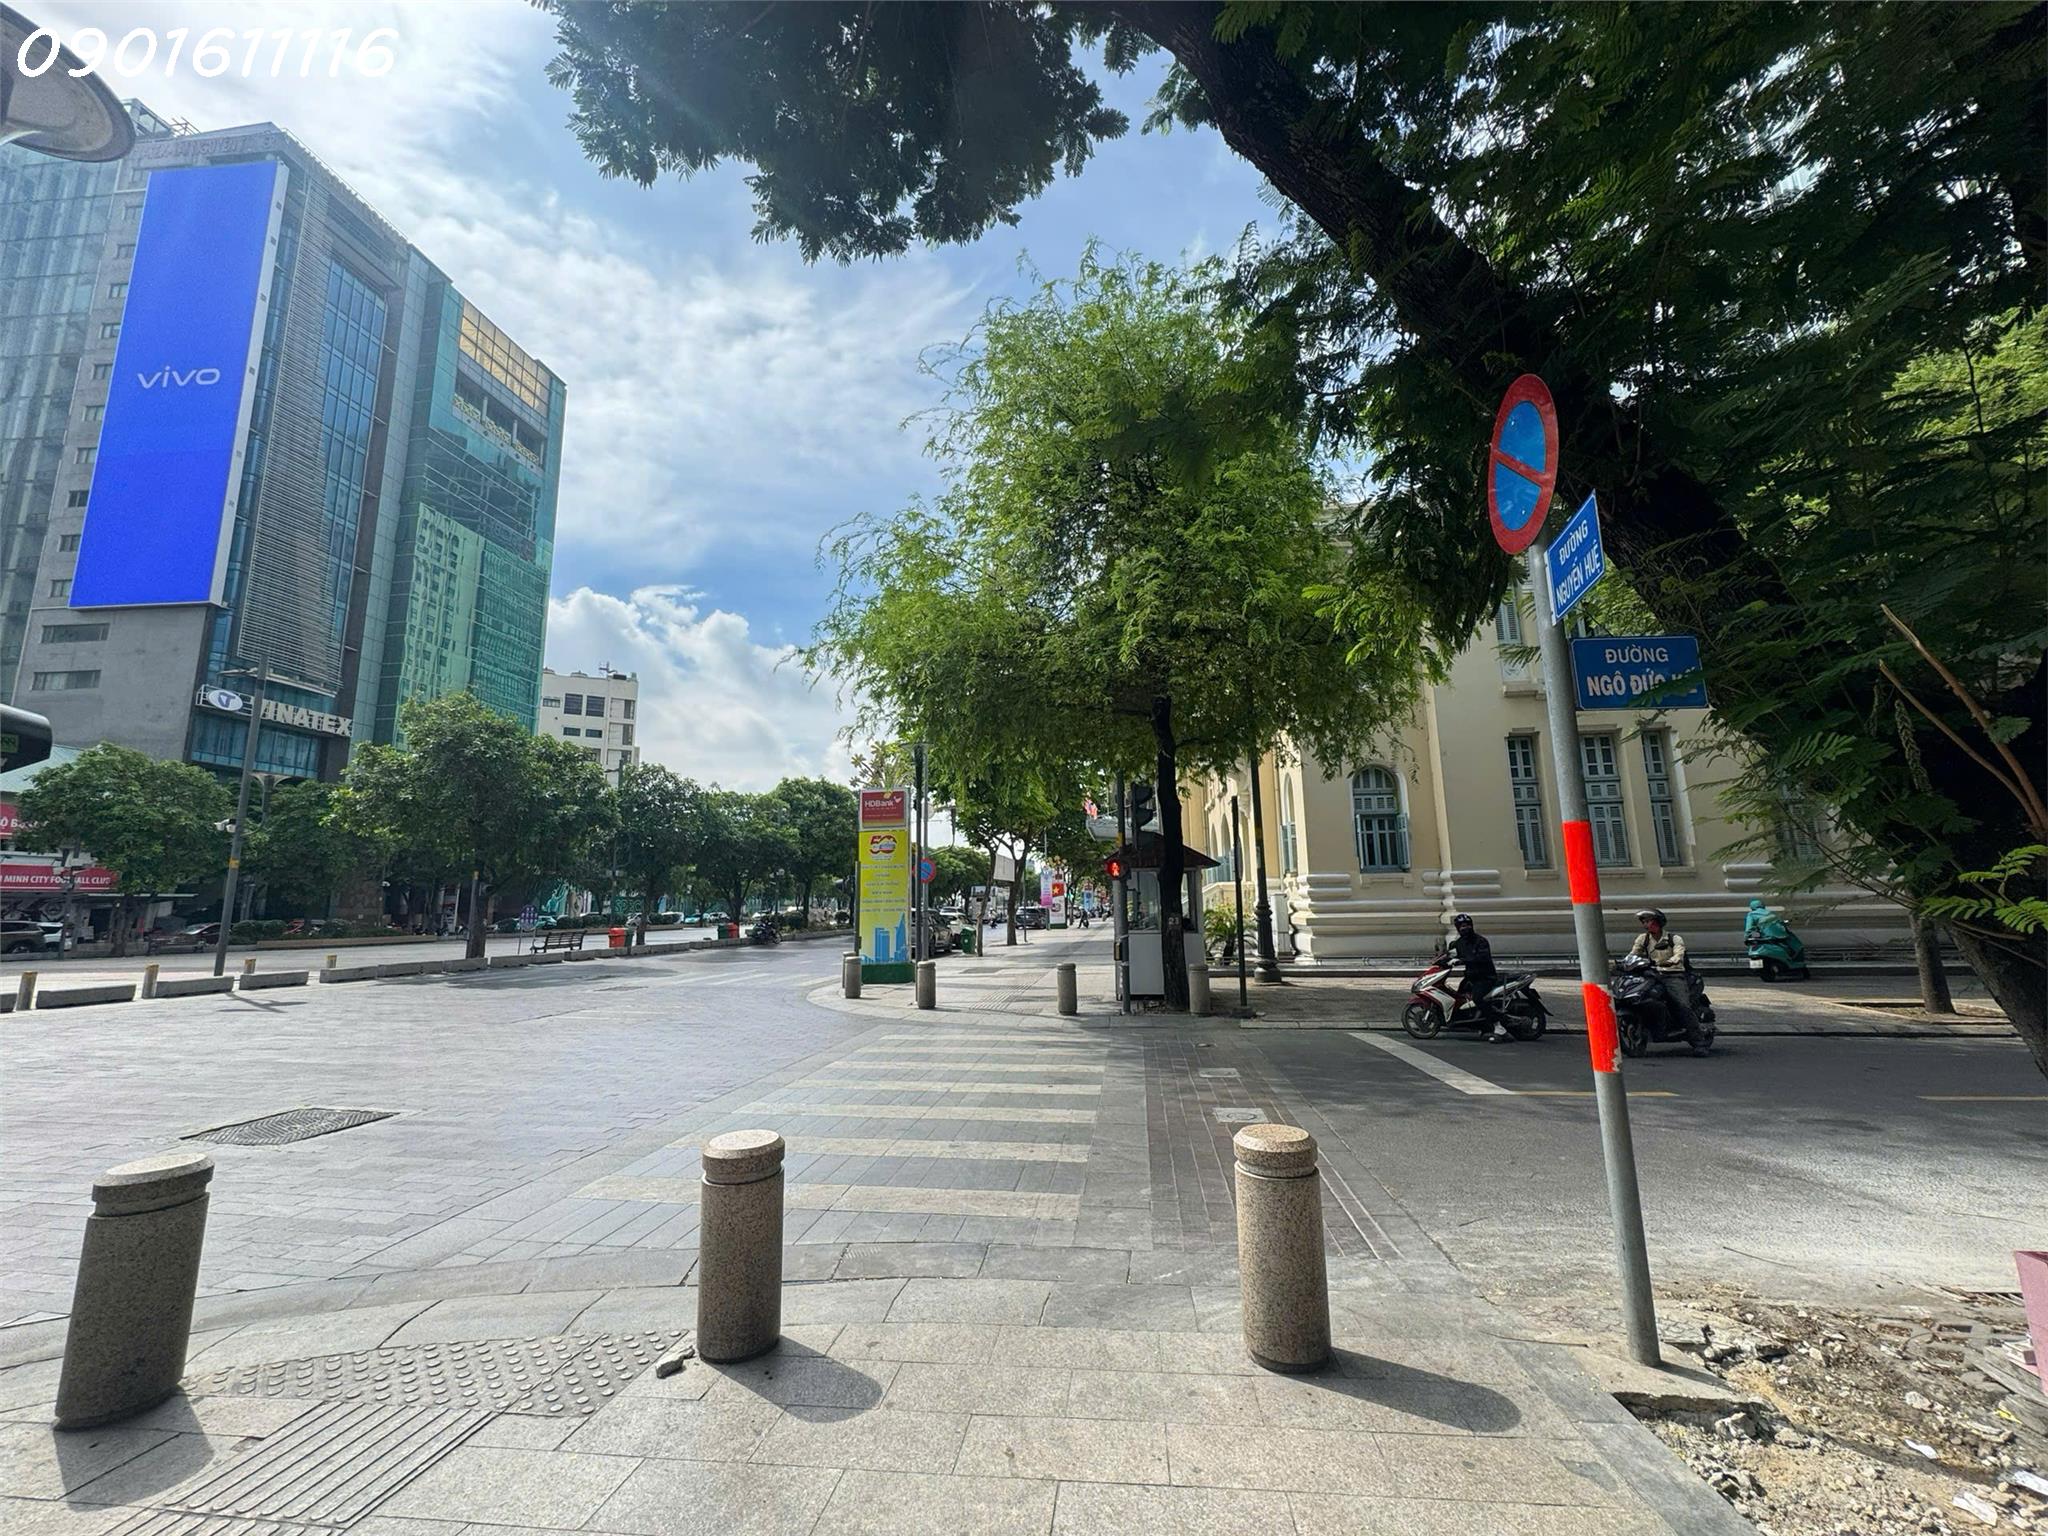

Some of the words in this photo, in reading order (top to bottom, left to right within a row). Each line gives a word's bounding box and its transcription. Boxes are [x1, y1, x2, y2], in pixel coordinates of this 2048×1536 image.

[137, 365, 221, 389] vivo
[1559, 519, 1588, 566] ĐƯỜNG
[1605, 643, 1669, 664] ĐƯỜNG
[1586, 670, 1626, 697] NGÔ
[864, 799, 894, 808] HDBank
[3, 875, 29, 884] MINH
[30, 875, 50, 884] CITY
